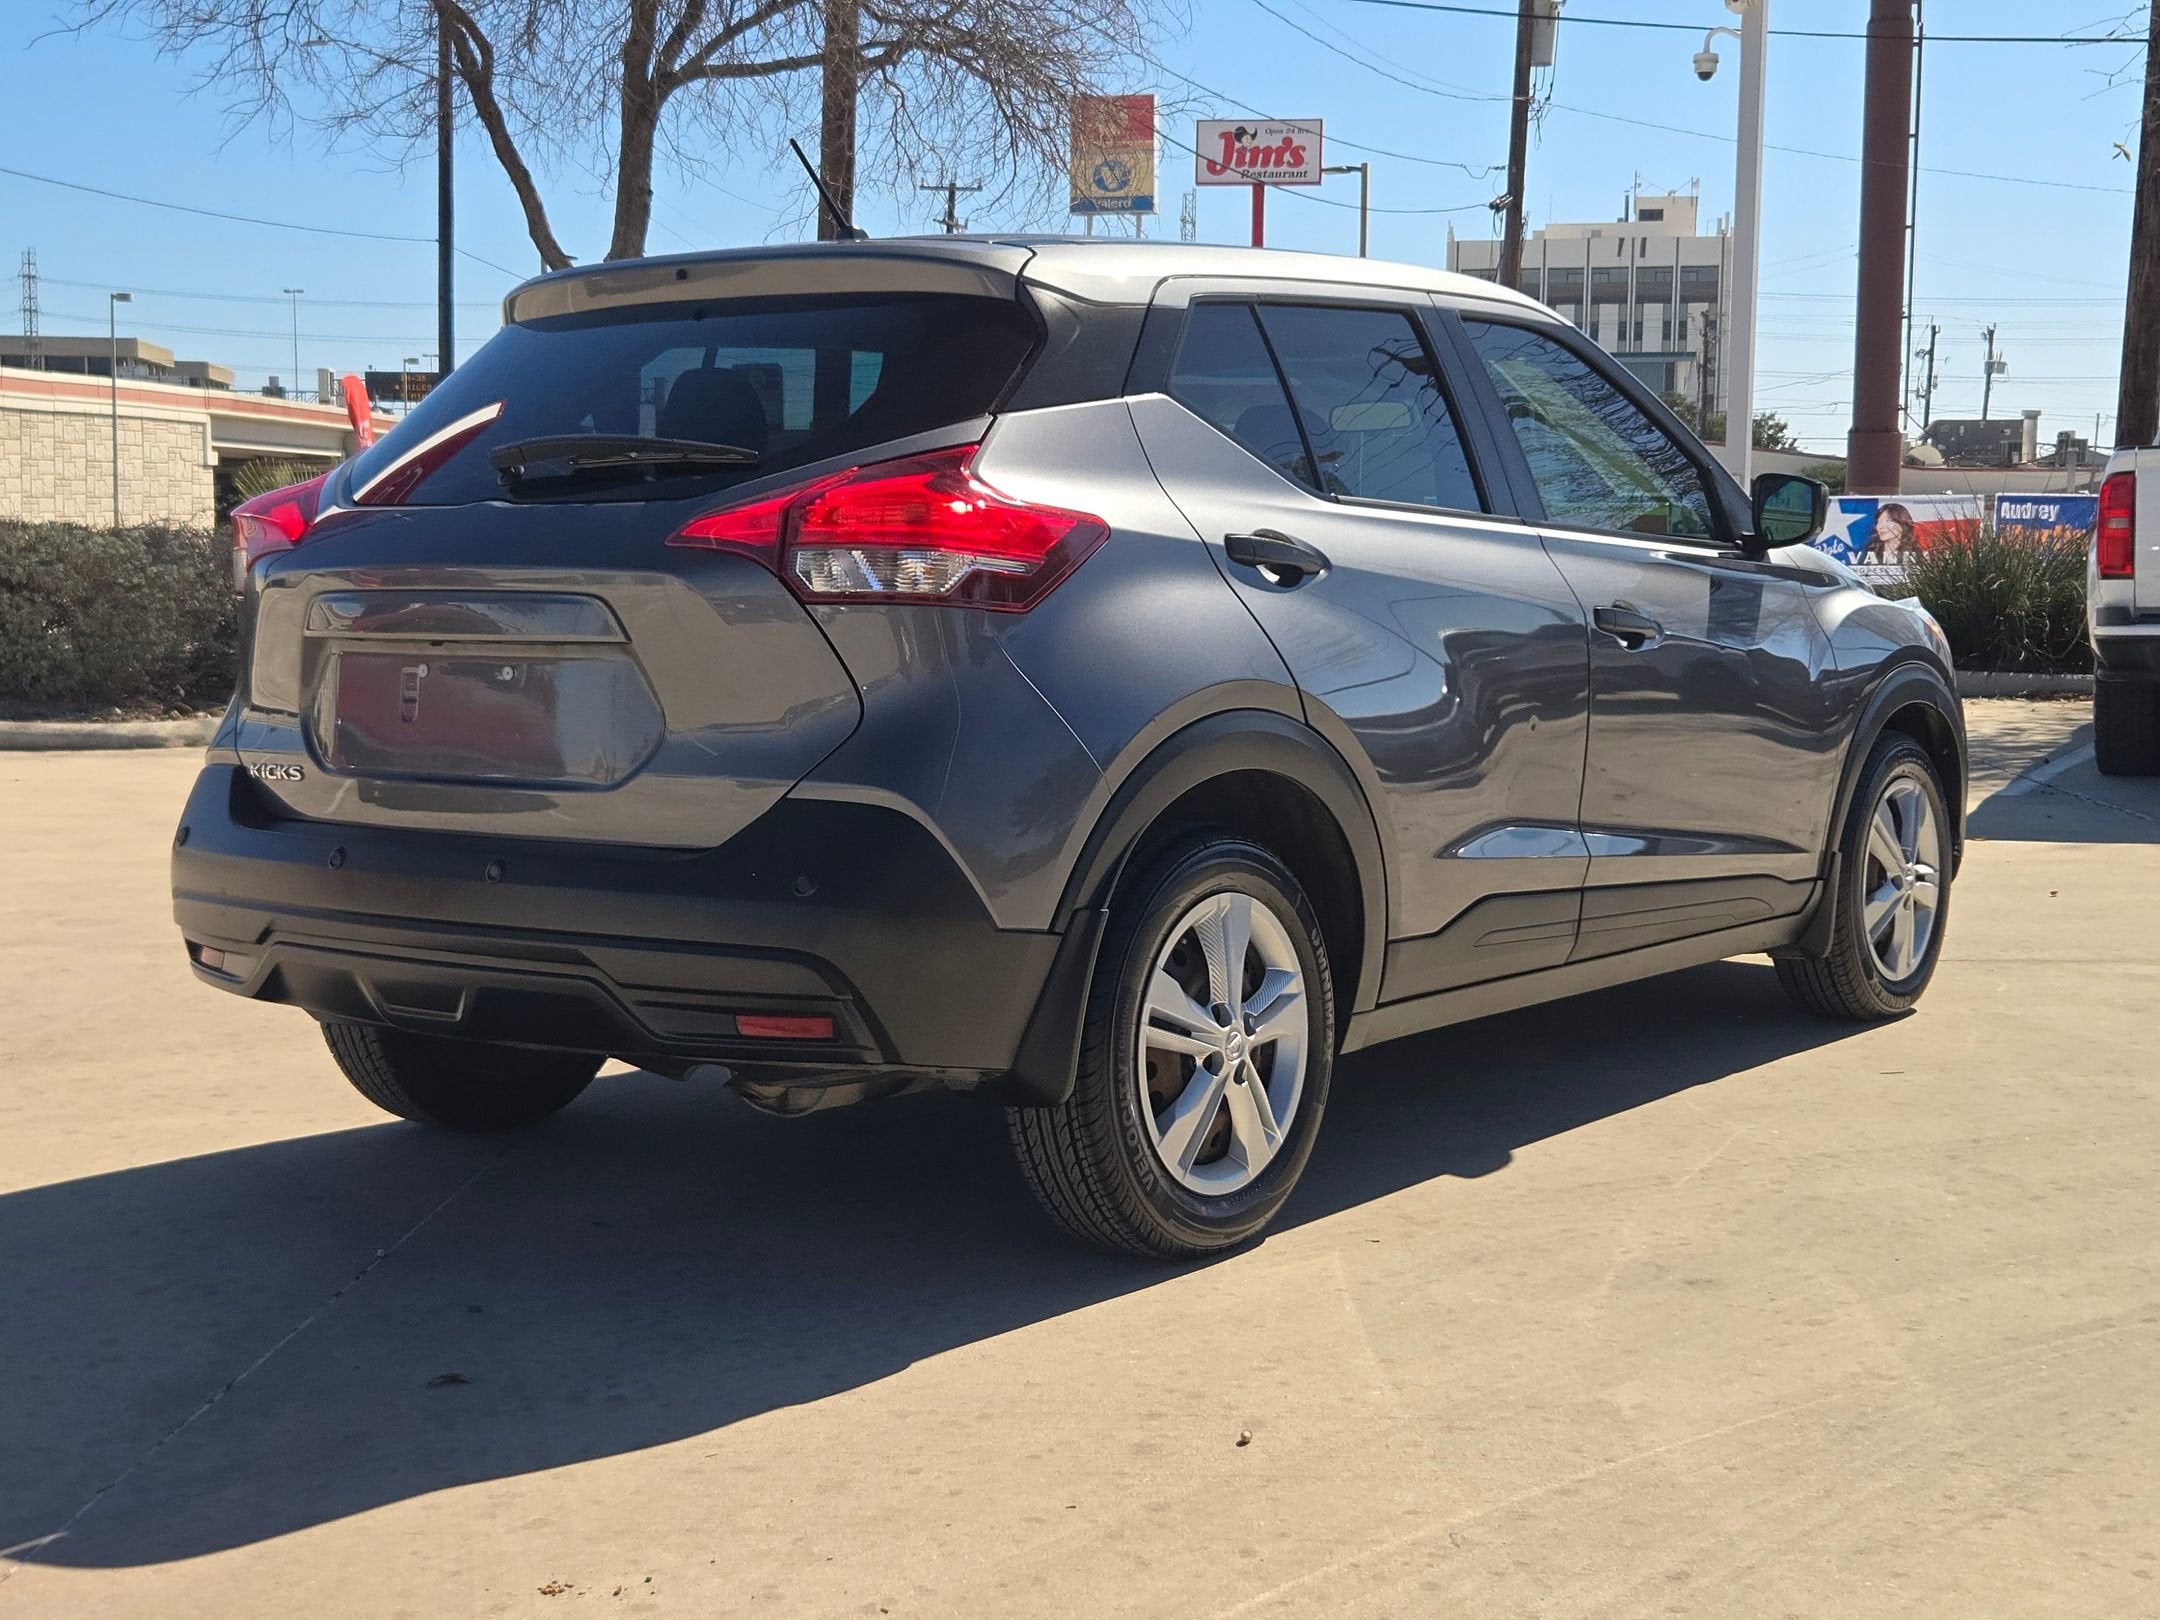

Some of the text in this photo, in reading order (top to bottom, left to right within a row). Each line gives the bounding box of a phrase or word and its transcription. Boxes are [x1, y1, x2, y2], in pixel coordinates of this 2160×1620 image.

[1206, 131, 1306, 176] Jim's
[1240, 169, 1308, 179] Restaurant
[2000, 502, 2060, 522] Audrey
[1814, 539, 1844, 556] Vote
[249, 763, 303, 781] KICKS
[1118, 1064, 1155, 1192] VELOCITY
